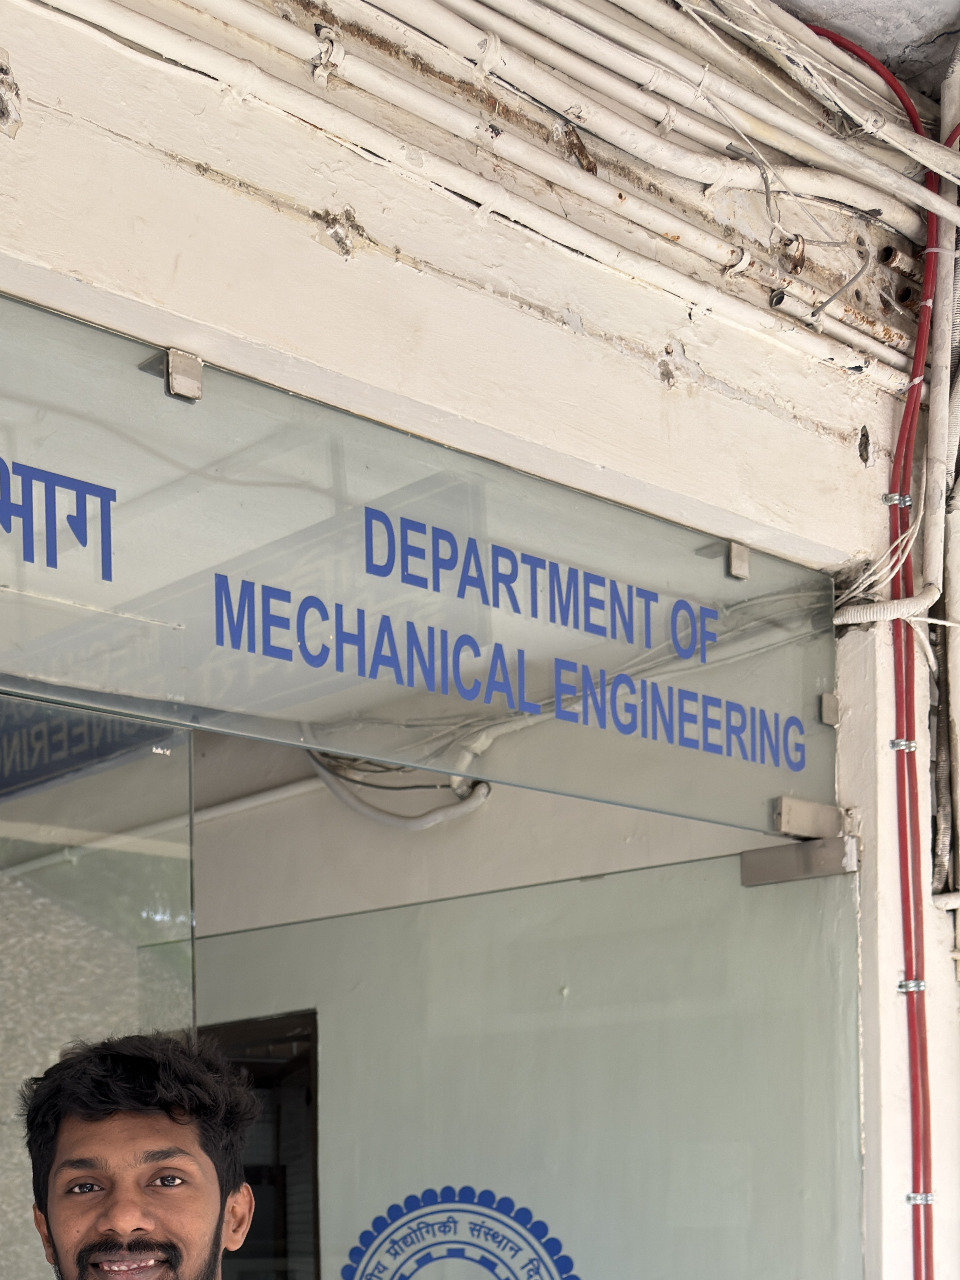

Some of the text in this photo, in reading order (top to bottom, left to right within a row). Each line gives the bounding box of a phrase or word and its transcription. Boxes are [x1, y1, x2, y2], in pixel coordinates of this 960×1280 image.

[364, 506, 719, 664] DEPARTMENT OF
[214, 573, 806, 772] MECHANICAL ENGINEERING
[468, 1220, 524, 1260] संस्थान
